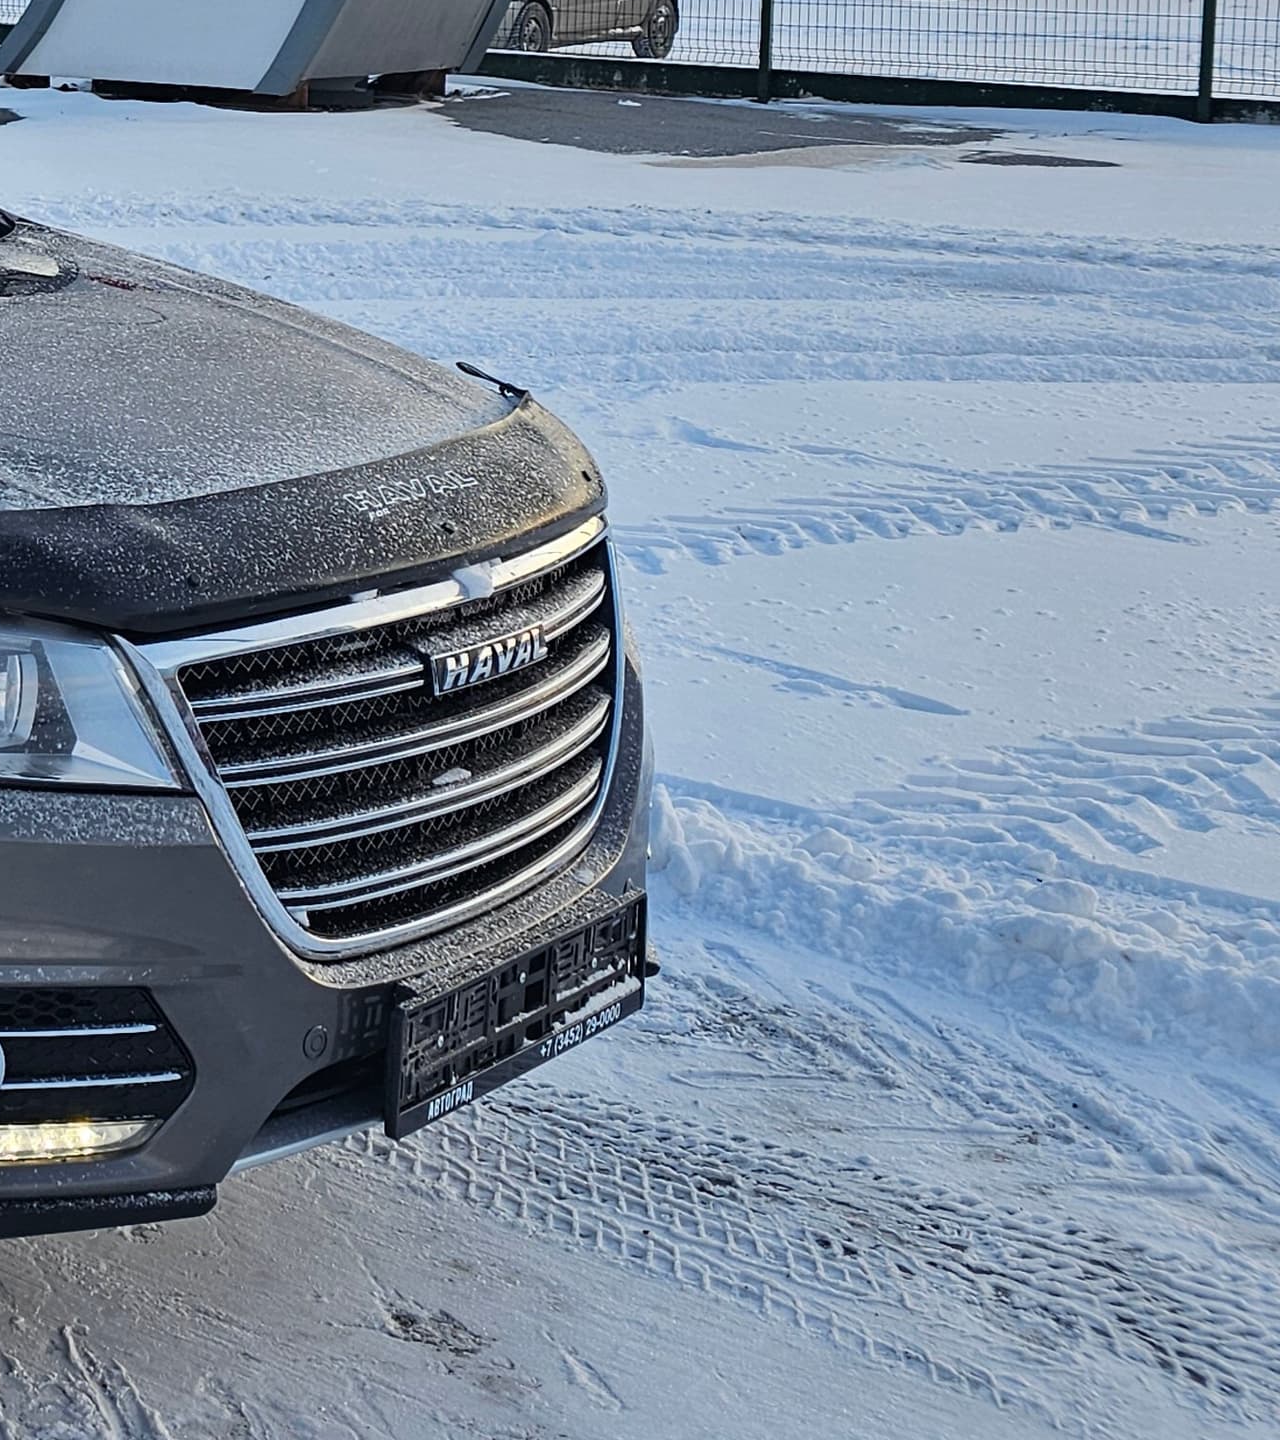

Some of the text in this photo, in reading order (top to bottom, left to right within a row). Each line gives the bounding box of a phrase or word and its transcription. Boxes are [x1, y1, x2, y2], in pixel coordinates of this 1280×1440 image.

[343, 470, 478, 510] HAVAL
[443, 628, 548, 690] HAVAL
[540, 1002, 621, 1057] +7 (3452) 29-0000
[427, 1080, 474, 1121] АВТОГРАД
